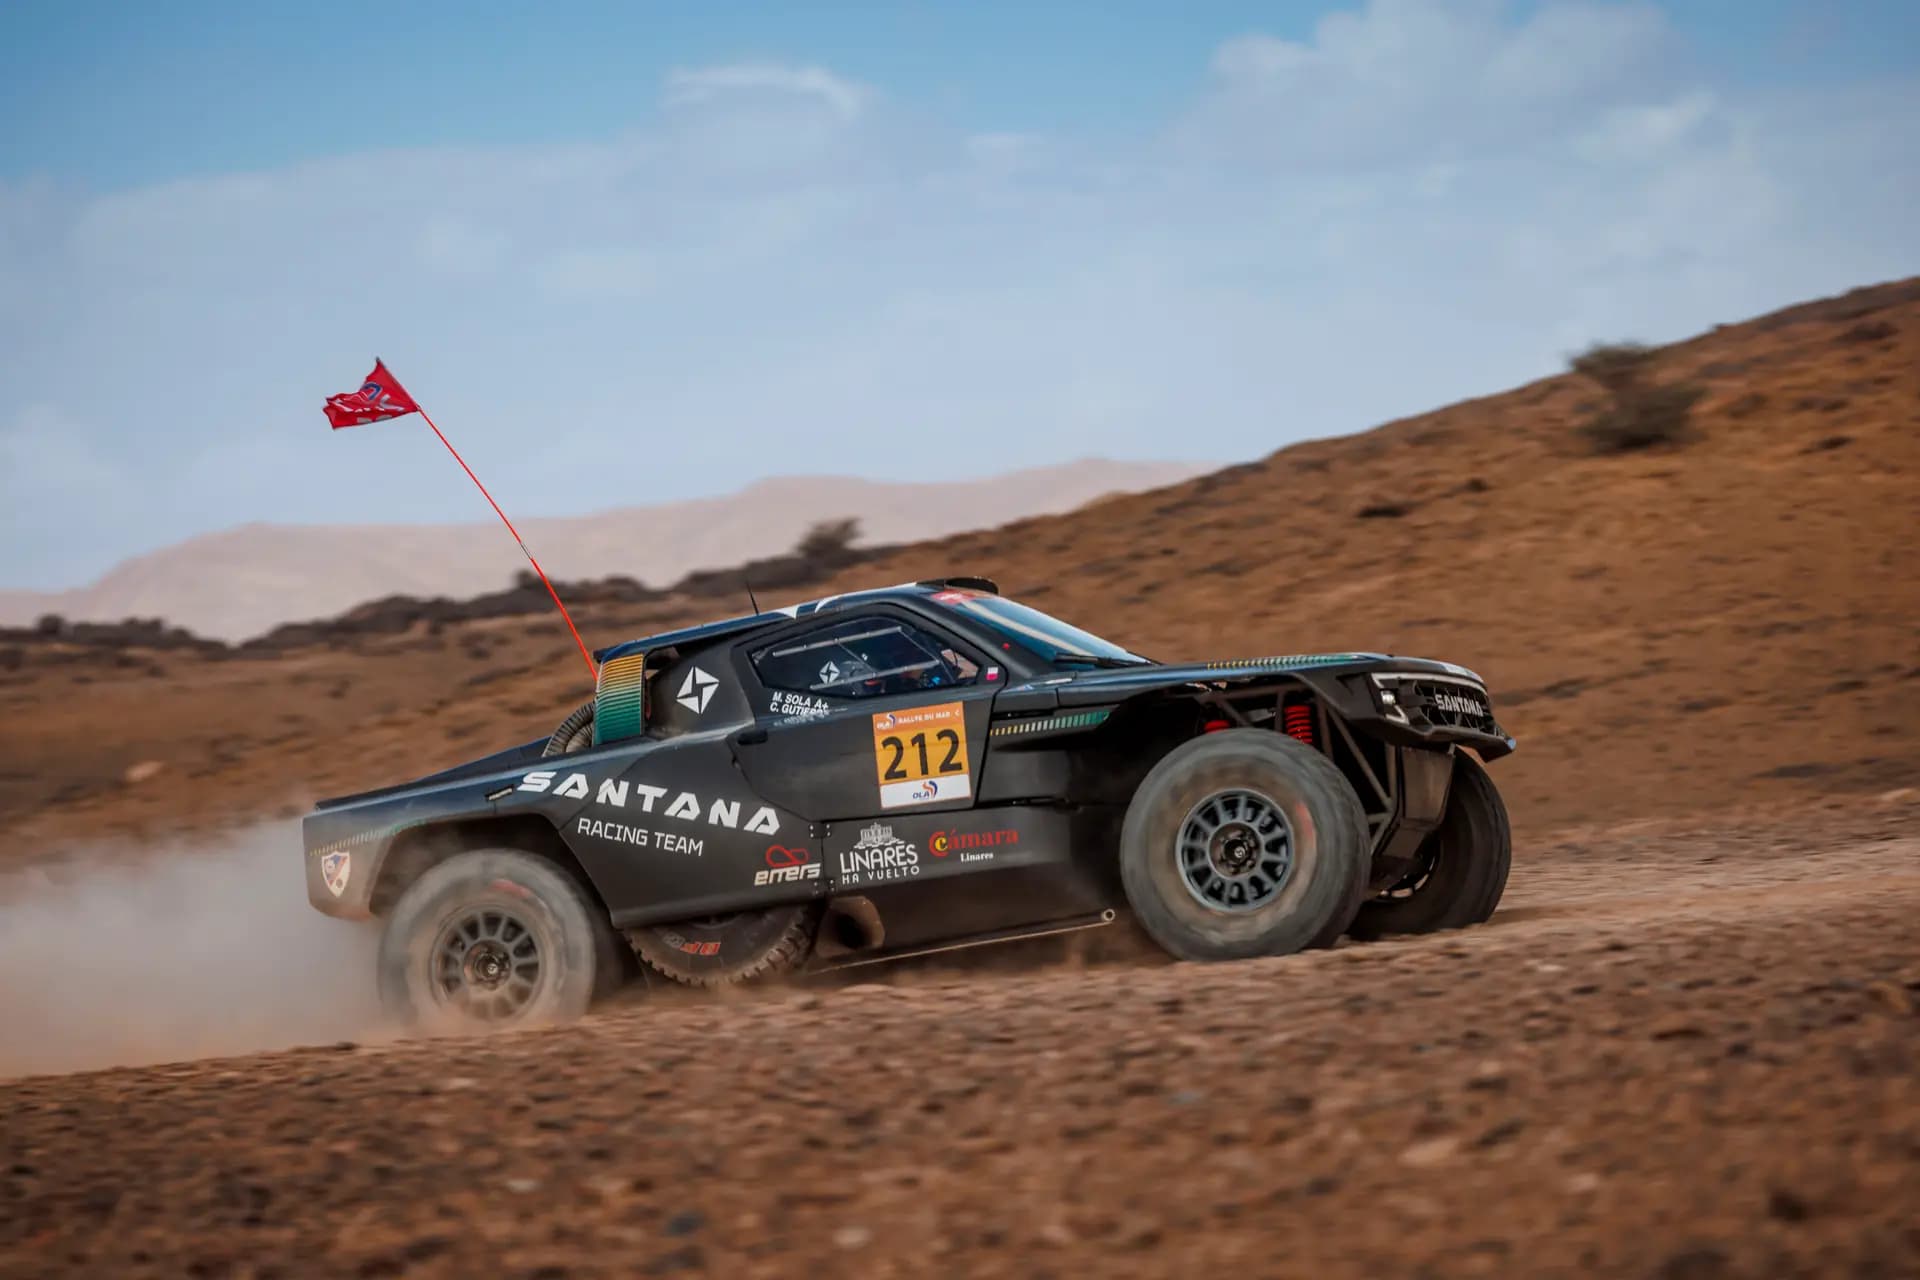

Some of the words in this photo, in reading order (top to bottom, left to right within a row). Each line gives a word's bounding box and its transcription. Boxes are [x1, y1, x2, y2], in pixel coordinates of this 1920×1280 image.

[770, 702, 779, 713] C.
[772, 691, 783, 703] M.
[785, 694, 811, 706] SOLA
[1435, 694, 1484, 717] SANTANA
[881, 728, 963, 780] 212
[517, 771, 781, 835] SANTANA
[912, 790, 930, 799] OLA
[578, 818, 648, 846] RACING
[654, 832, 703, 857] TEAM
[839, 843, 919, 874] LINARES
[960, 852, 994, 863] Linares
[842, 873, 860, 885] HA
[867, 865, 920, 881] VUELTO
